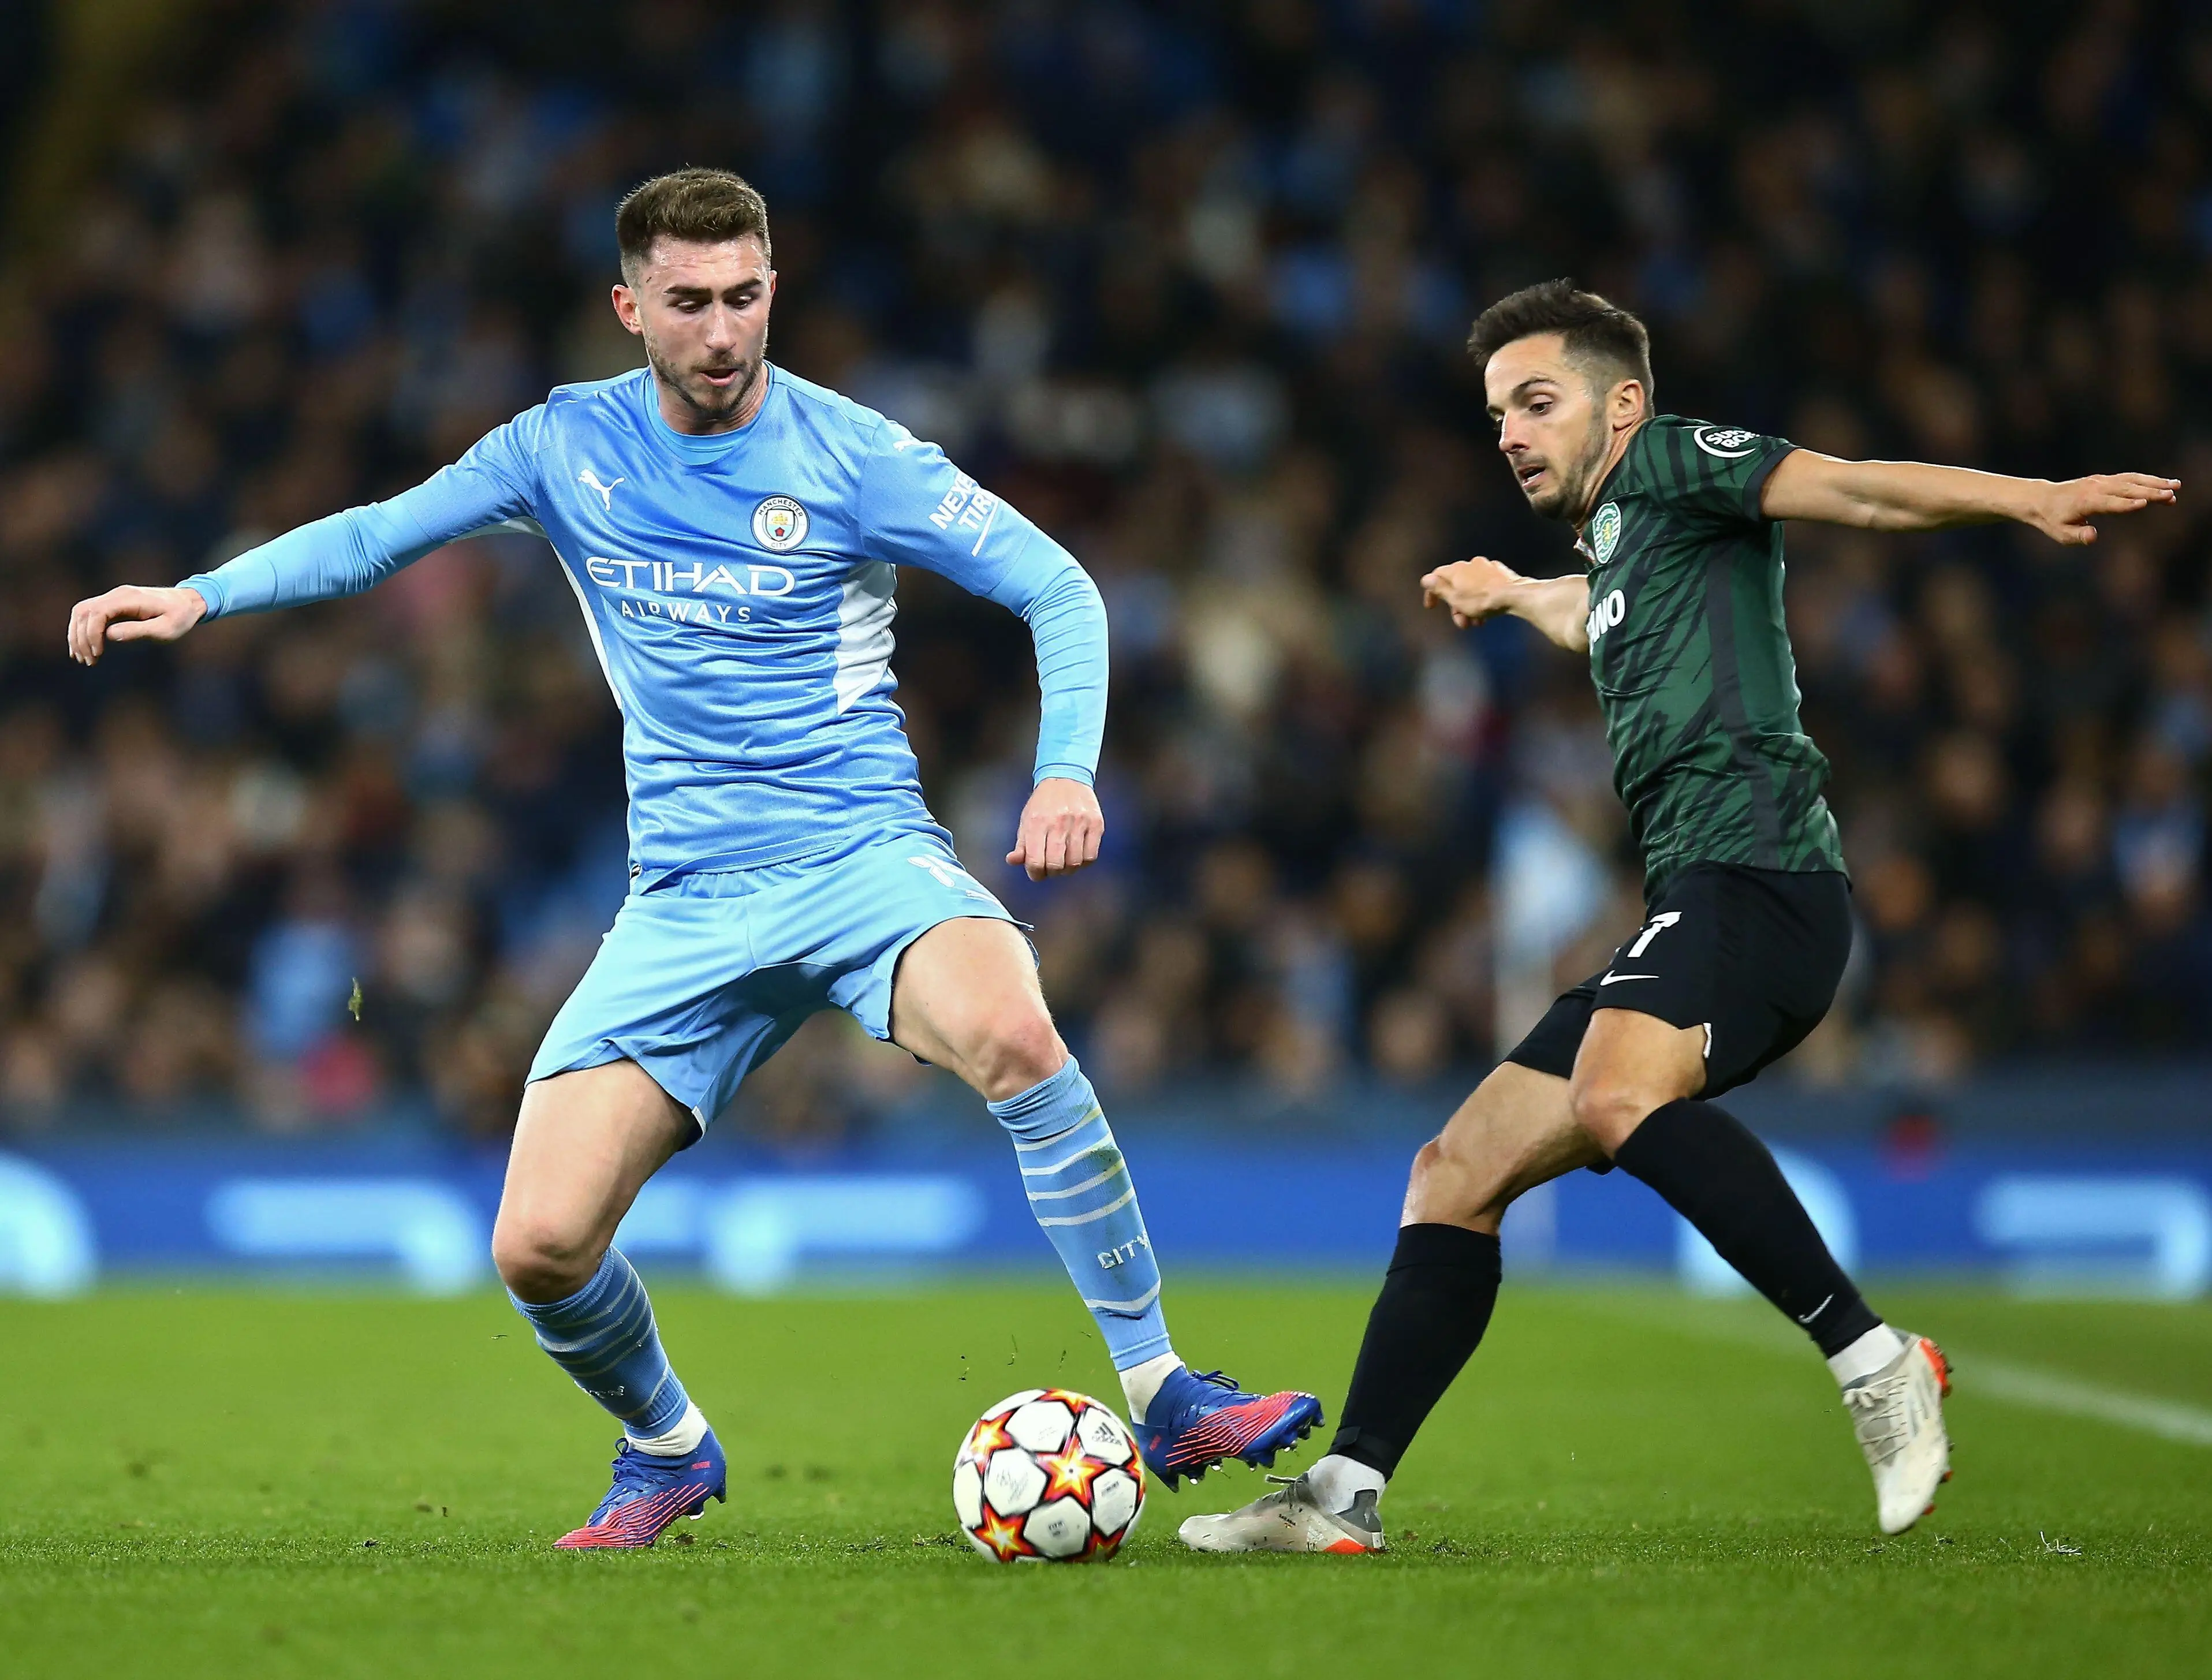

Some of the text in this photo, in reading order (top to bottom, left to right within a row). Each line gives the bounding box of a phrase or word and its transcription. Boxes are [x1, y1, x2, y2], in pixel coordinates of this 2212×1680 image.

[758, 499, 804, 517] MANCHESTER
[585, 557, 796, 596] ETIHAD
[621, 600, 751, 623] AIRWAYS
[1616, 911, 1683, 958] 7
[1097, 1230, 1149, 1269] CITY
